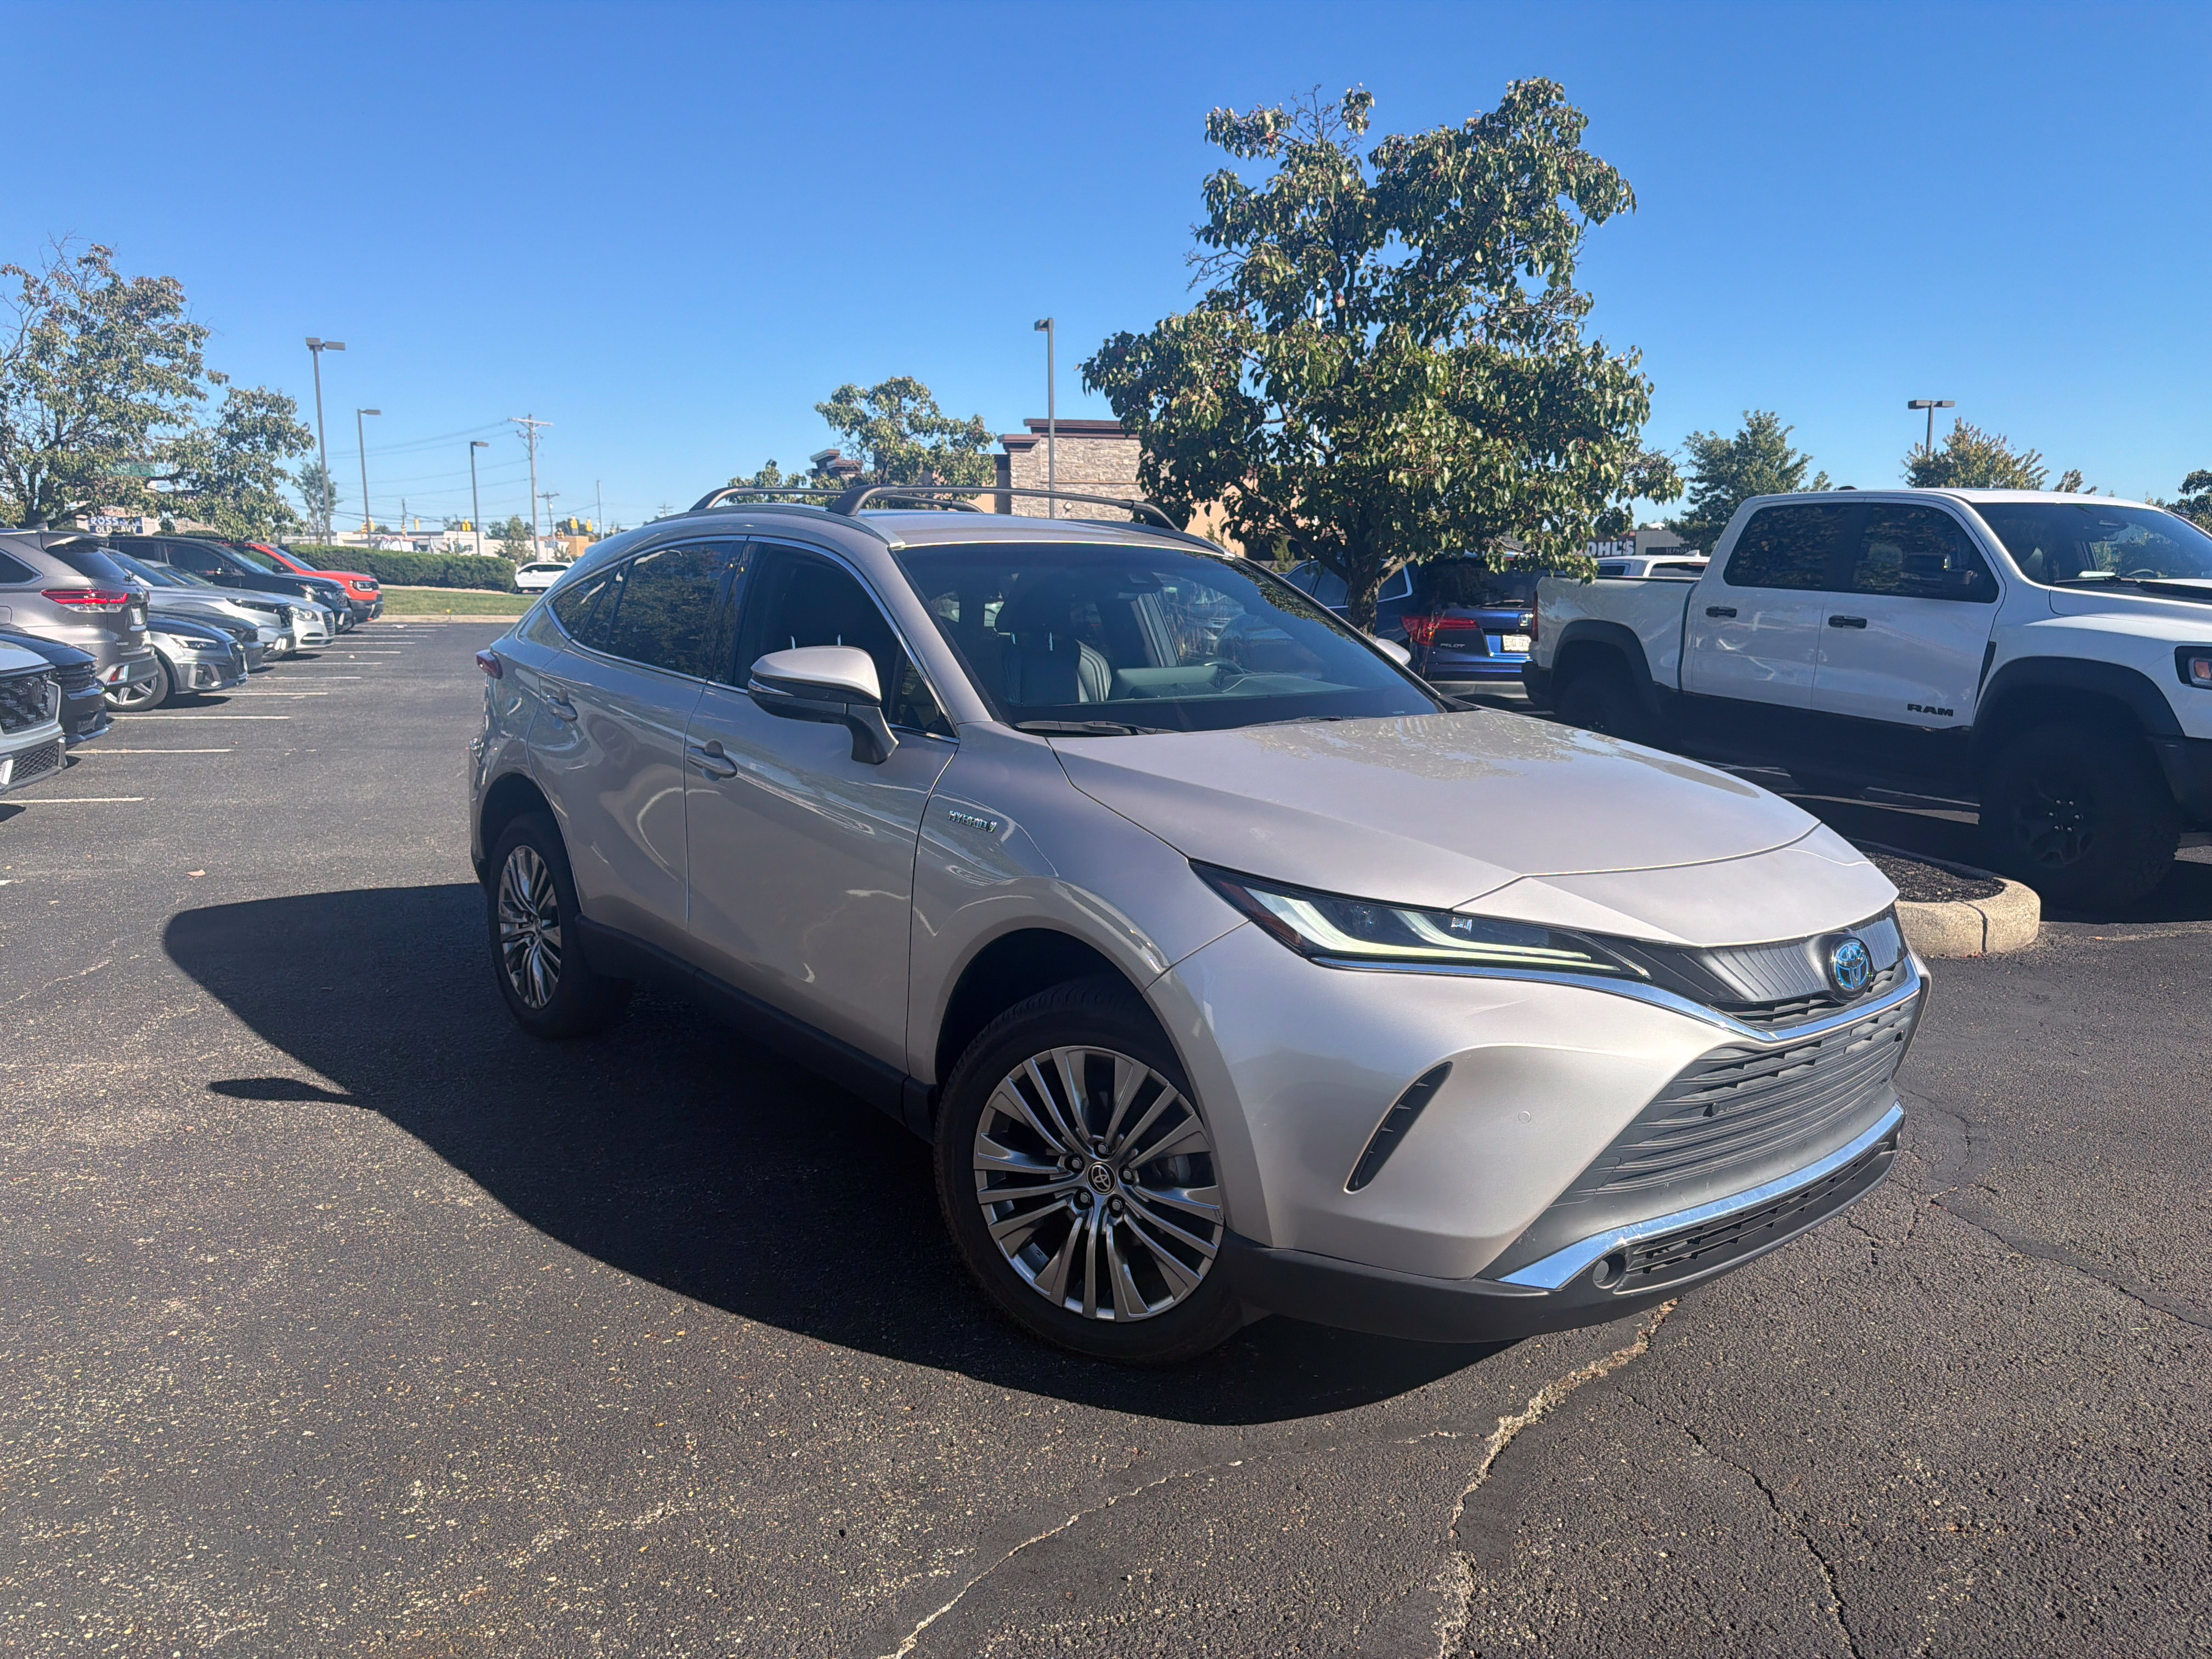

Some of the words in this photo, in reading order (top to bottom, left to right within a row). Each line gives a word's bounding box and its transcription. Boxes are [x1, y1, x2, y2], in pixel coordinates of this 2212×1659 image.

[91, 516, 119, 525] ROSS
[1575, 540, 1634, 557] OHL'S
[1908, 704, 1953, 716] RAM
